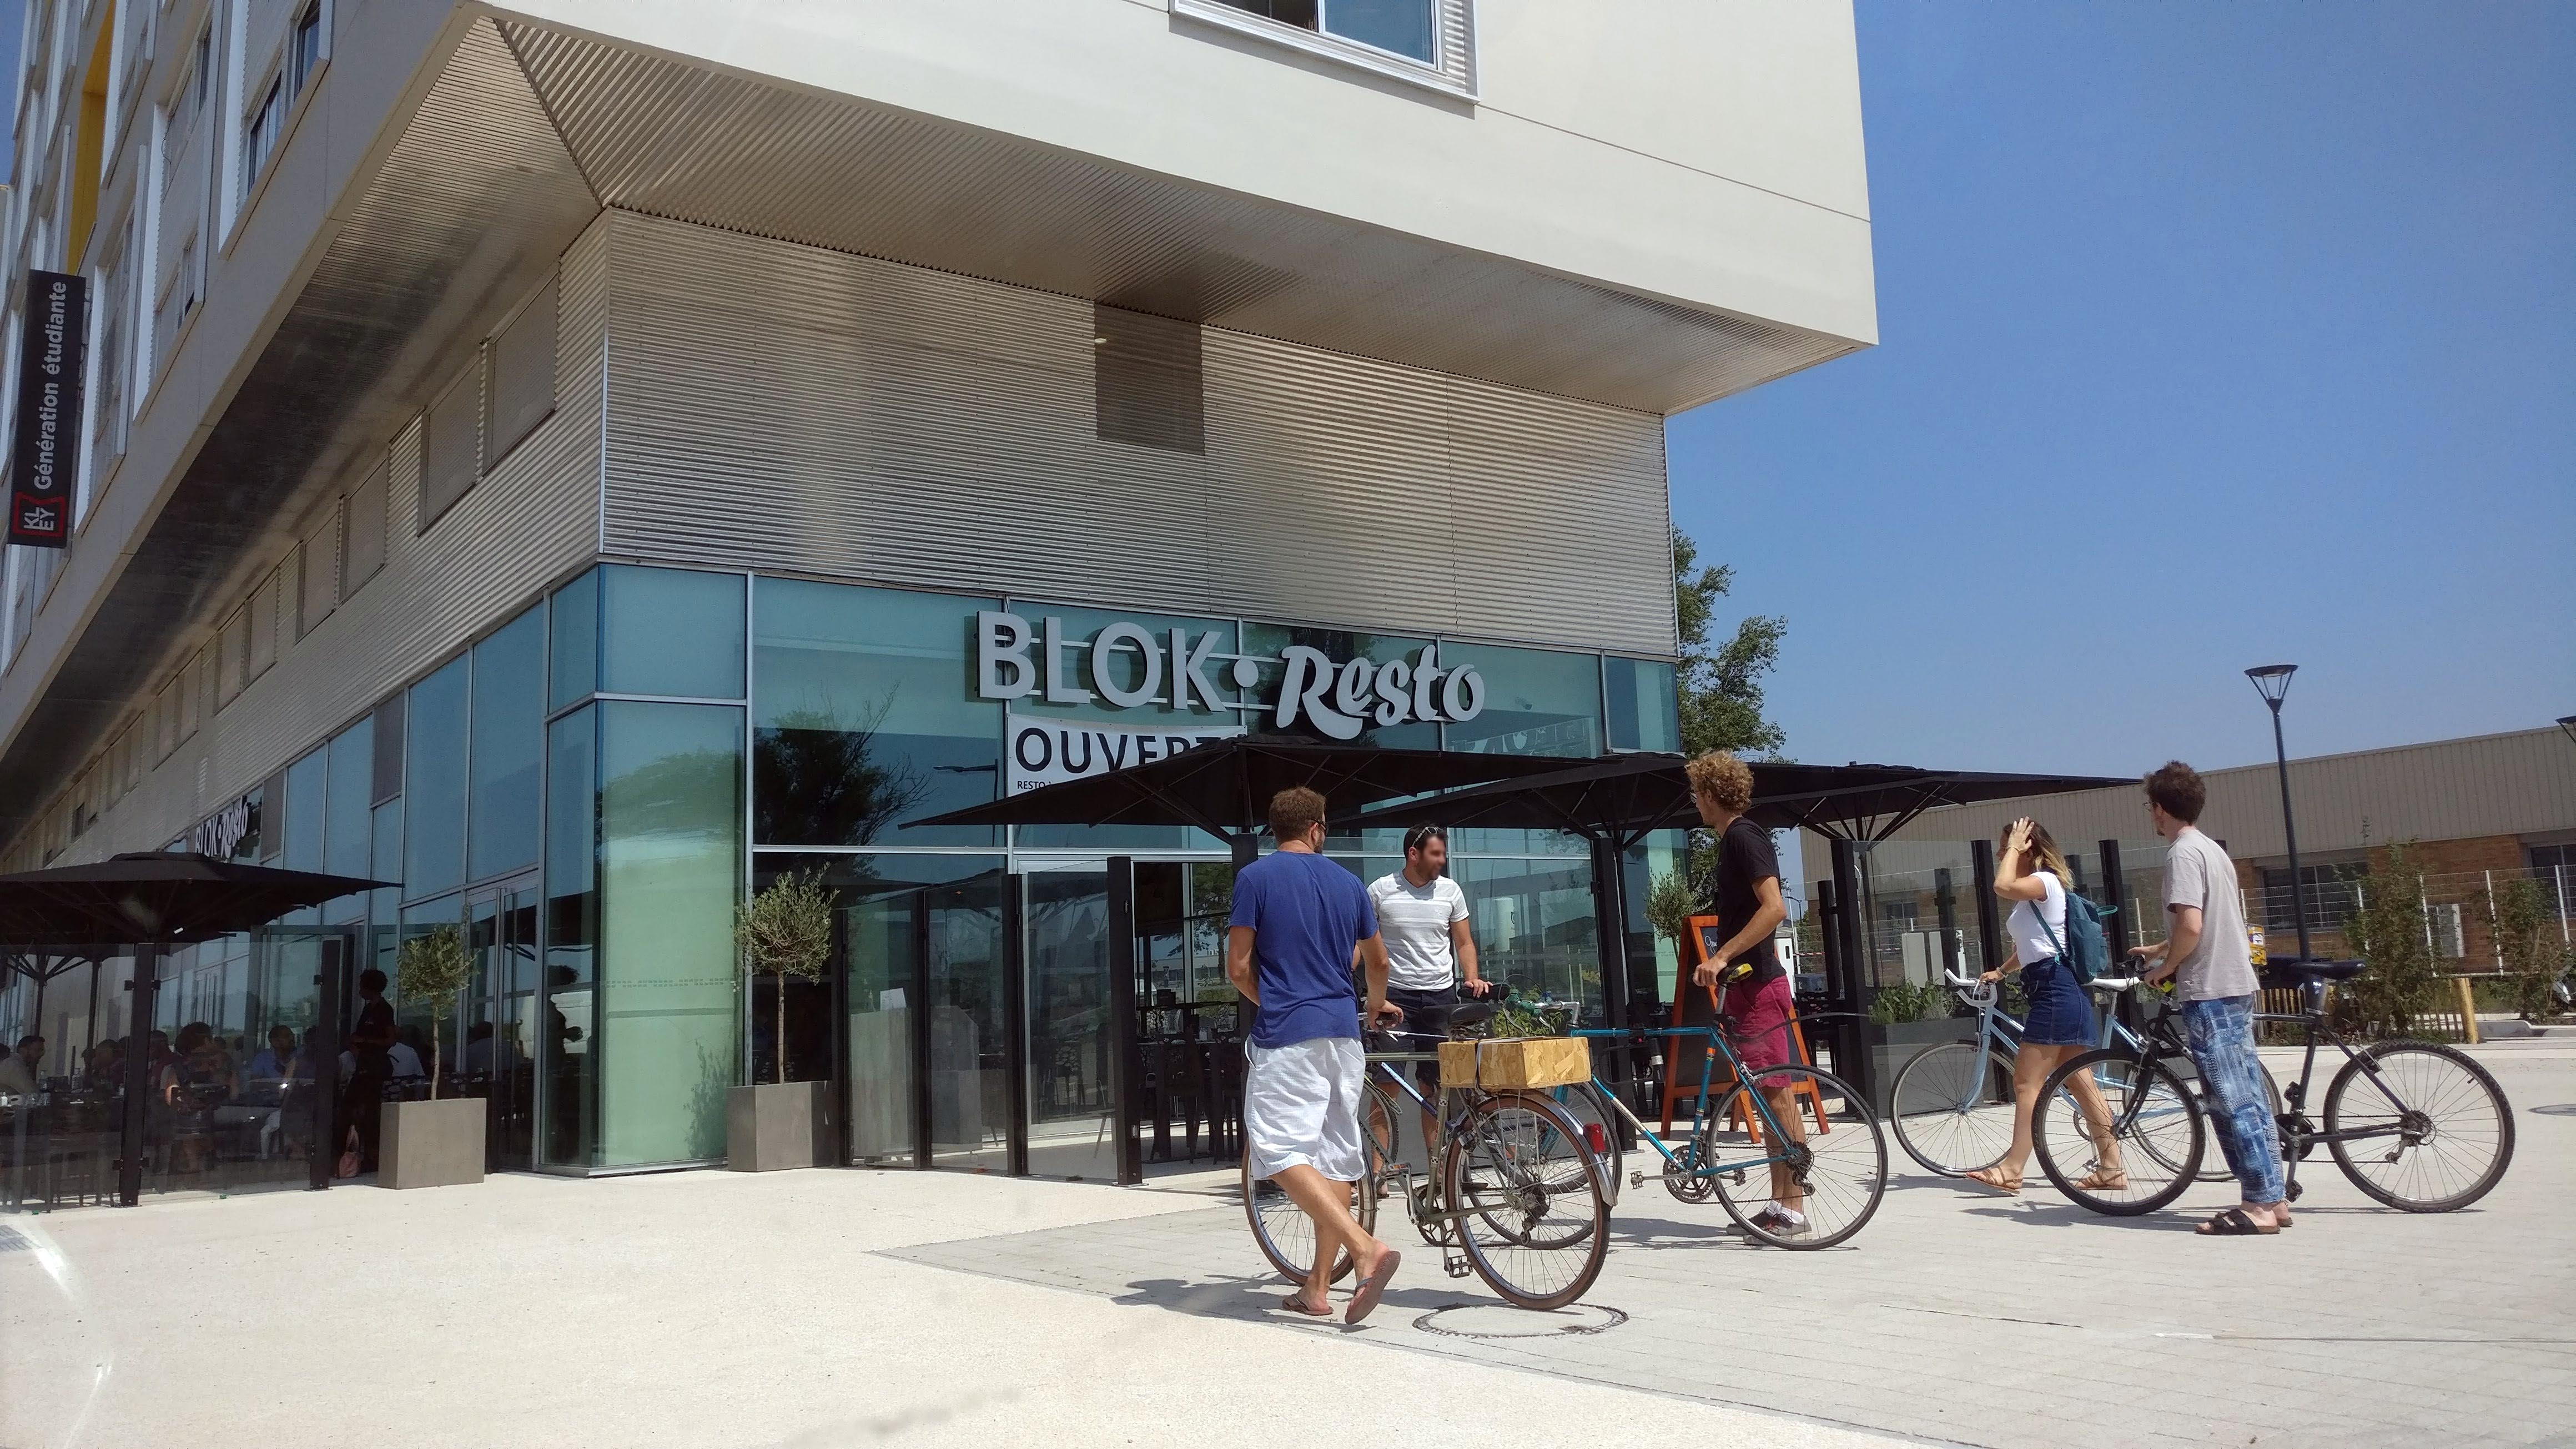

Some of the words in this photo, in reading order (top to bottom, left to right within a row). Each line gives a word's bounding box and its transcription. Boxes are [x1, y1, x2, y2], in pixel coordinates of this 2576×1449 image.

[41, 281, 66, 375] étudiante
[34, 383, 58, 489] Génération
[977, 611, 1226, 712] BLOK
[1276, 645, 1485, 740] Resto
[1017, 781, 1045, 789] RESTO
